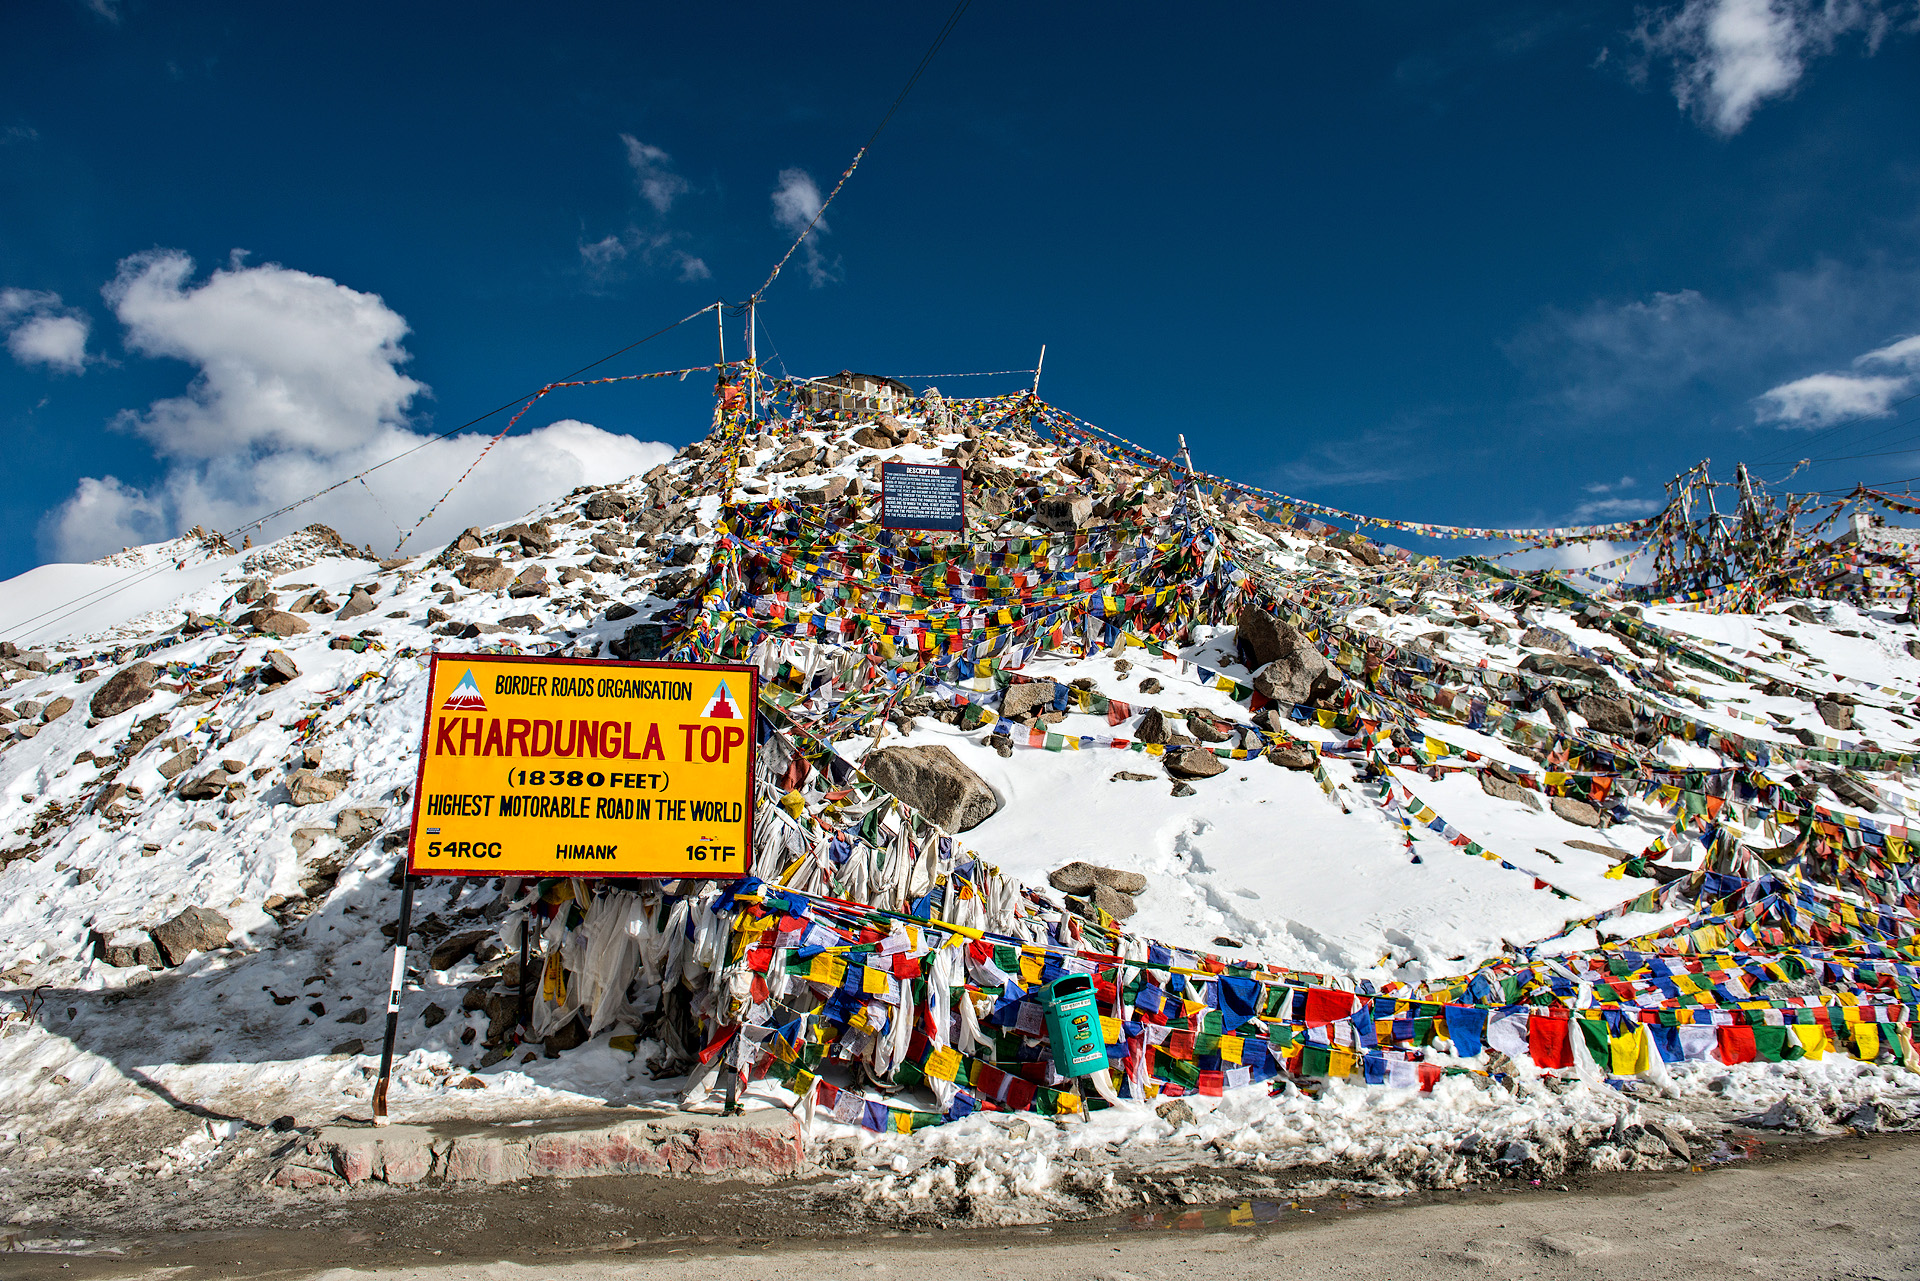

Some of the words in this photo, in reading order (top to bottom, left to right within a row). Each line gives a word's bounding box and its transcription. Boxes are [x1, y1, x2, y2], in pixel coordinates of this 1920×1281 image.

[907, 467, 940, 475] DESCRIPTION
[496, 675, 547, 696] BORDER
[552, 677, 594, 697] ROADS
[598, 679, 692, 701] ORGANISATION
[434, 717, 665, 760] KHARDUNGLA
[679, 724, 744, 763] TOP
[509, 767, 605, 788] (18380
[611, 771, 669, 792] FEET)
[428, 794, 495, 816] HIGHEST
[499, 795, 591, 818] MOTORABLE
[596, 797, 634, 819] ROAD
[636, 799, 650, 820] IN
[656, 800, 686, 820] THE
[690, 801, 742, 822] WORLD
[428, 842, 502, 858] 54RCC
[557, 844, 617, 859] HIMANK
[686, 846, 735, 862] 16TF
